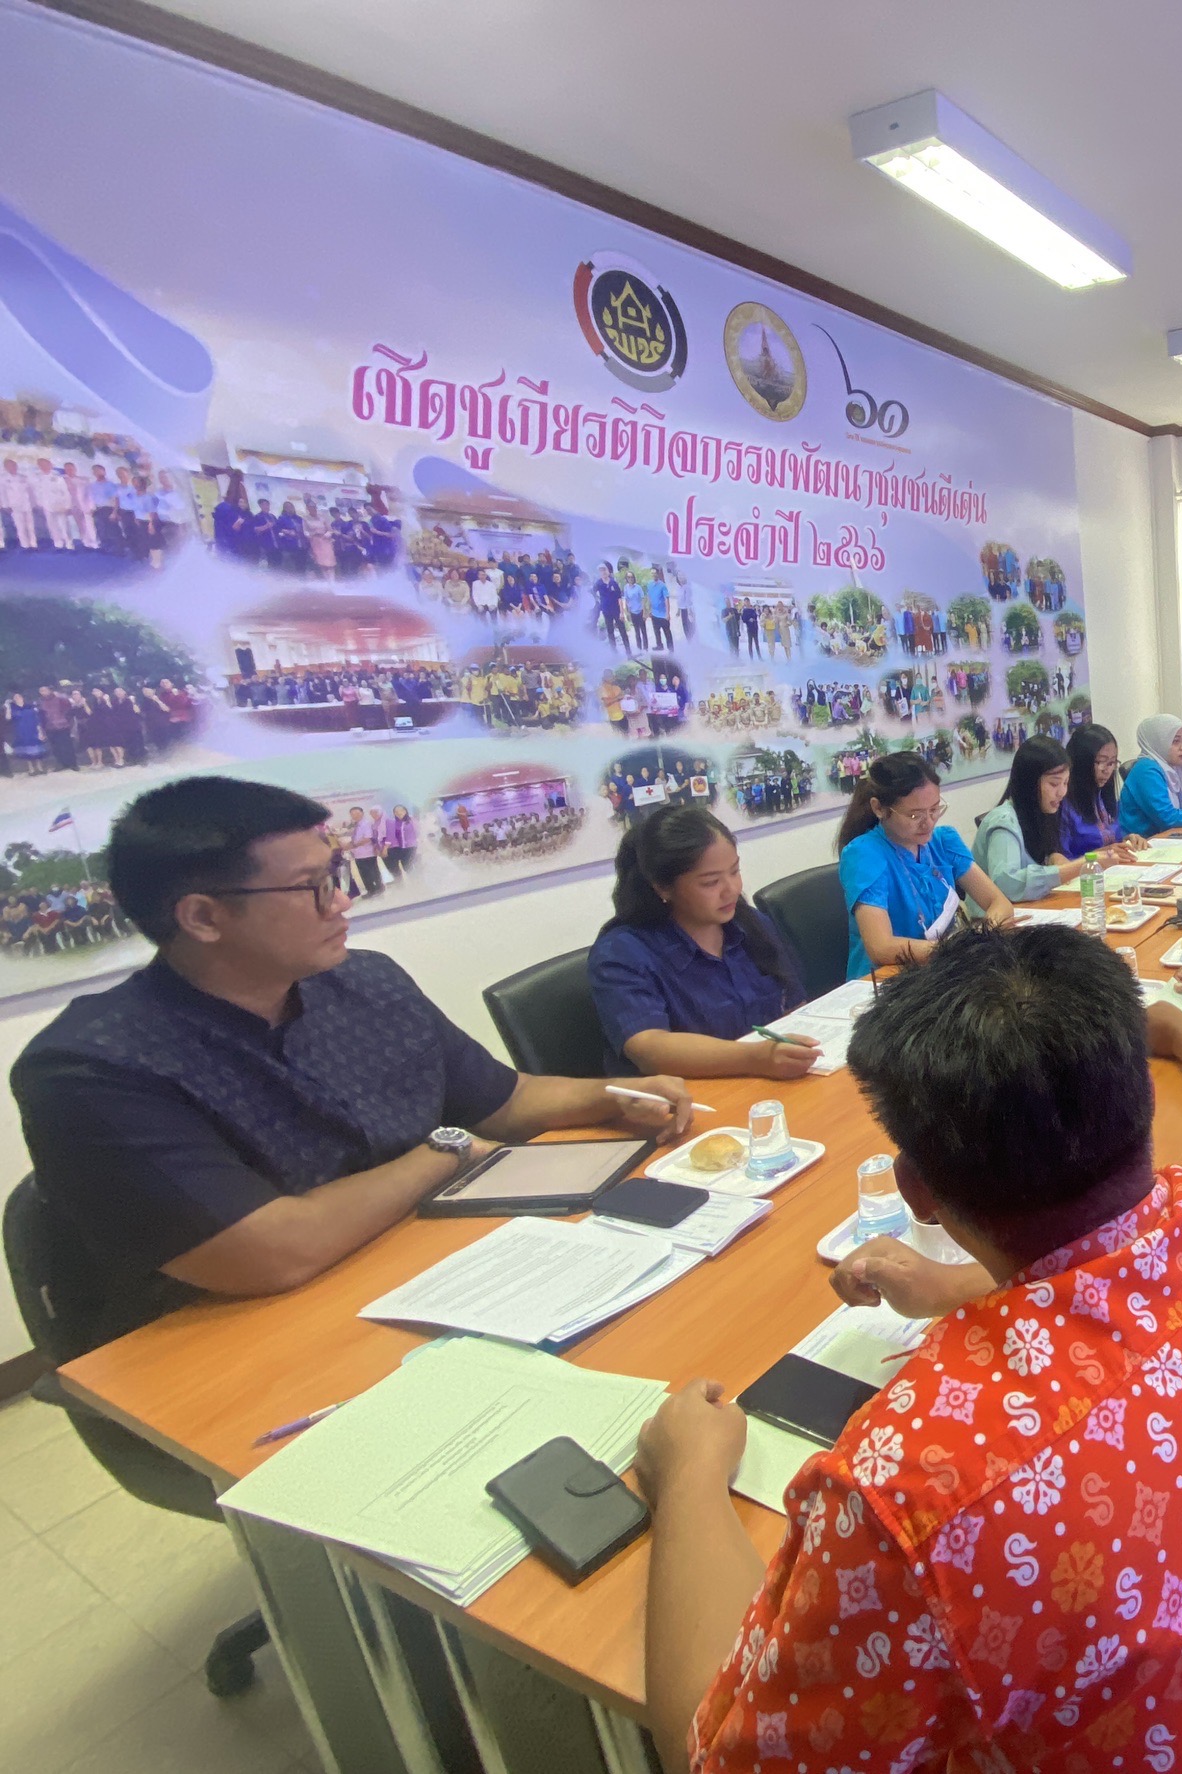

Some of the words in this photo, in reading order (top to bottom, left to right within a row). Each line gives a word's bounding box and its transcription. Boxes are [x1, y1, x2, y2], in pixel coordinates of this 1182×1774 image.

[352, 343, 988, 527] เชิดชูเกียรติกิจกรรมพัฒนาชุมชนดีเด่น
[666, 495, 802, 568] ประจำปี
[807, 520, 886, 572] ๒๕๖๖
